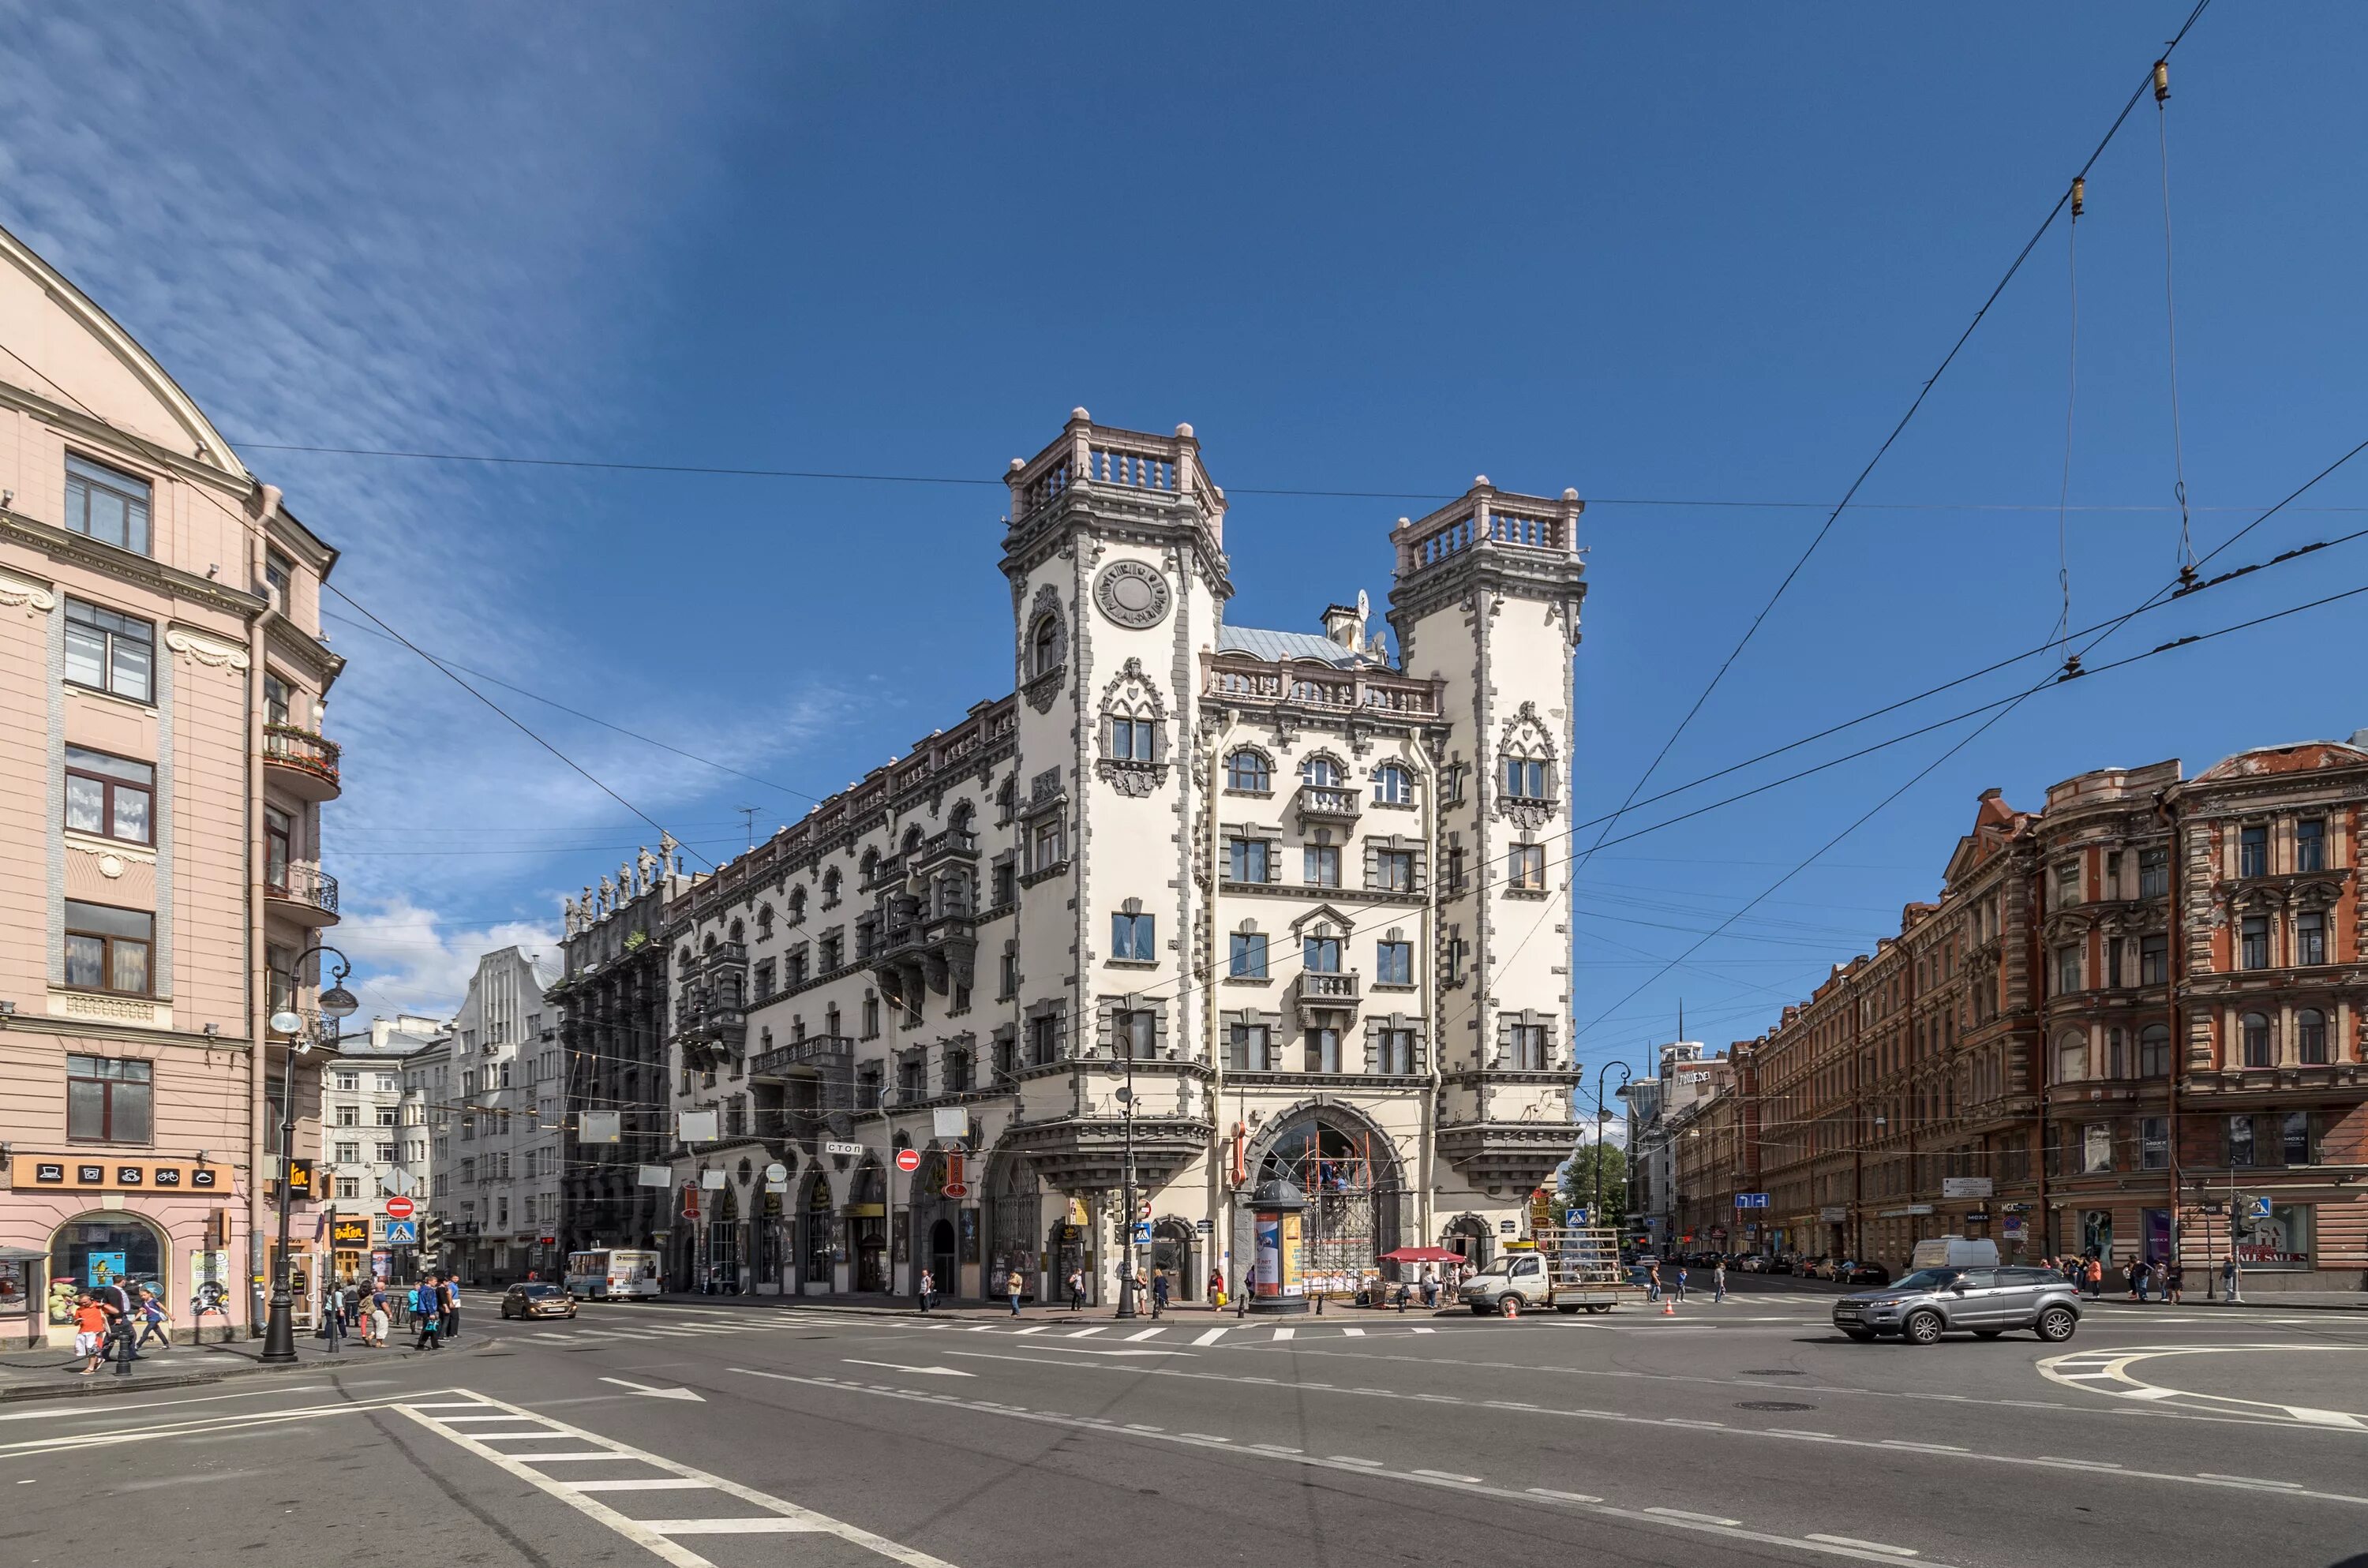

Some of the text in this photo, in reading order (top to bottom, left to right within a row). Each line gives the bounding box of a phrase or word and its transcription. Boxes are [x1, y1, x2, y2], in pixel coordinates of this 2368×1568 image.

[829, 1144, 860, 1153] СТОП
[290, 1162, 309, 1185] ter
[2260, 1226, 2281, 1237] SA
[2239, 1253, 2261, 1262] ALE
[2265, 1253, 2294, 1262] SALE
